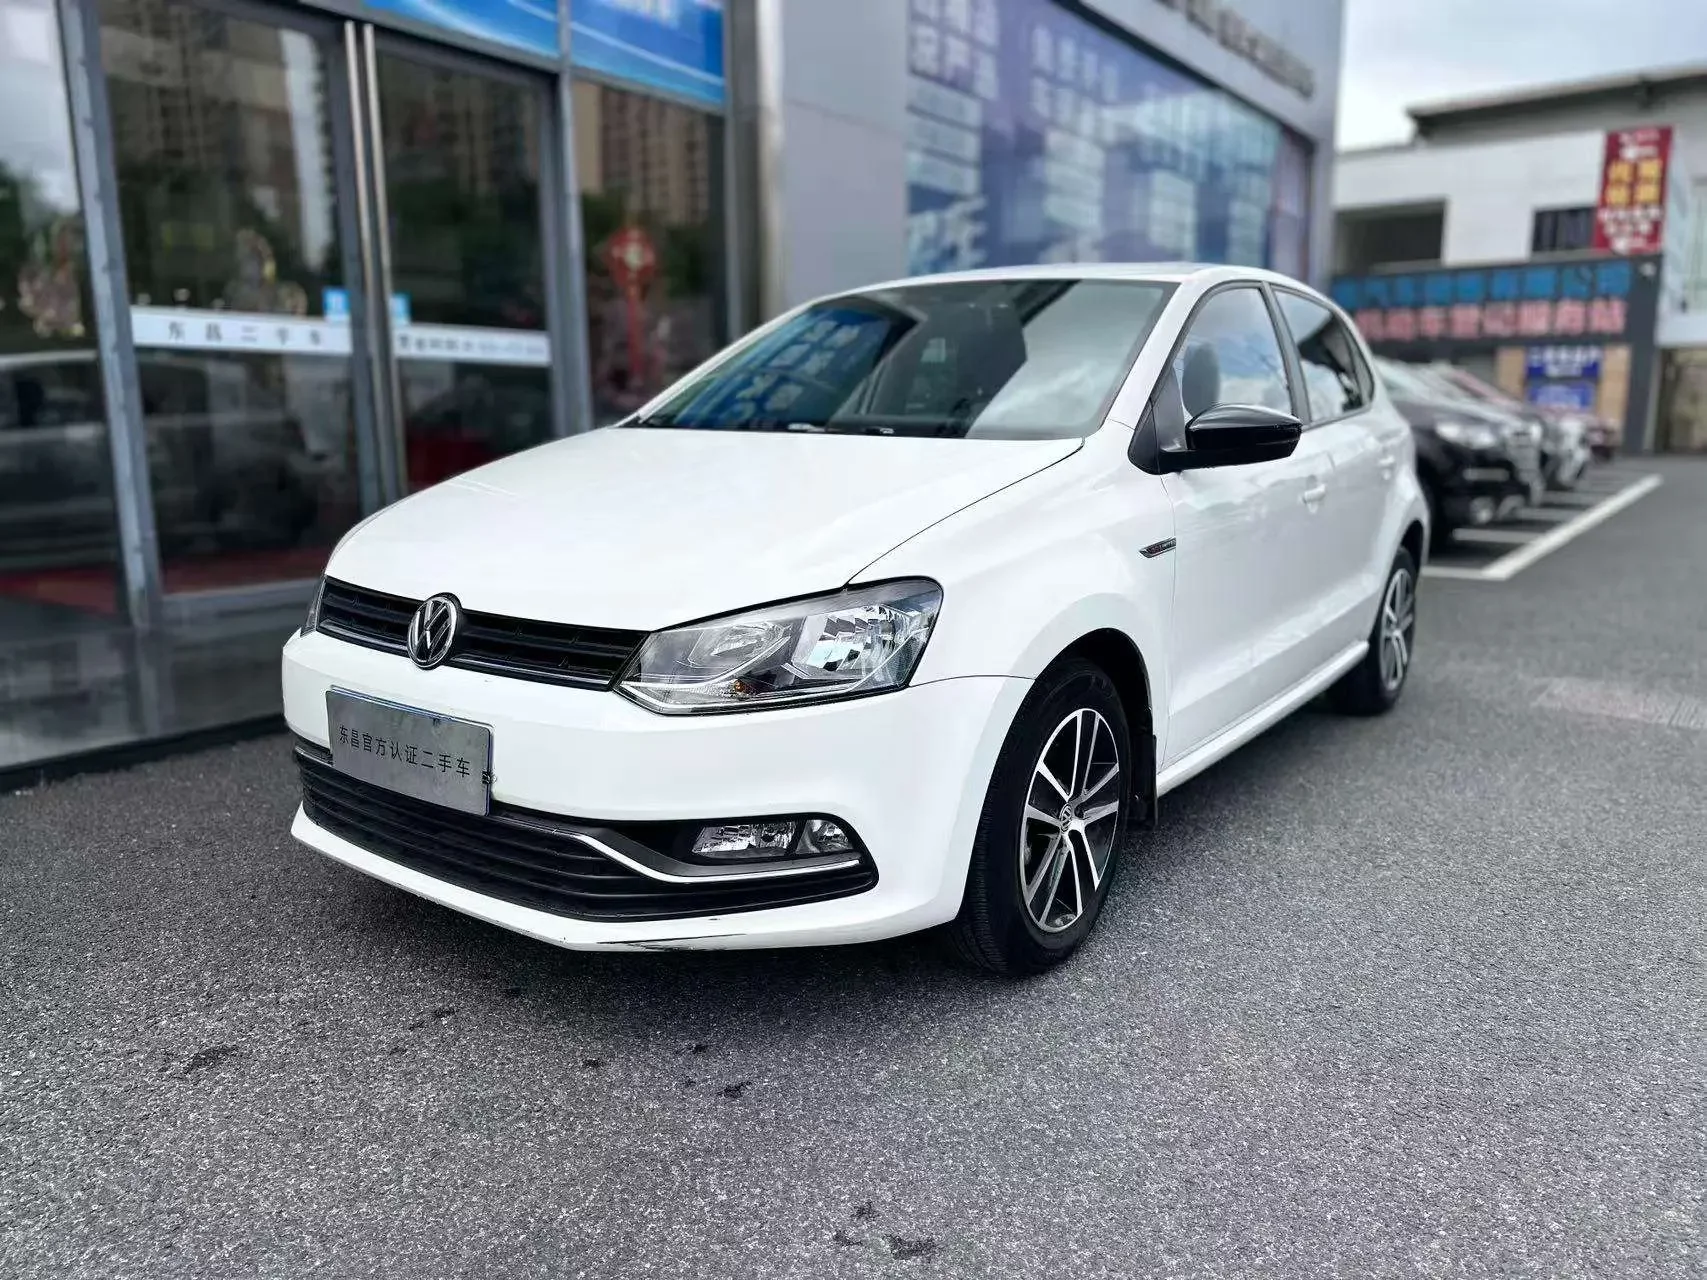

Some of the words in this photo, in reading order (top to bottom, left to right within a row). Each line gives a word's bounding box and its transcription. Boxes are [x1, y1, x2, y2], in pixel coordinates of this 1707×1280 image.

[168, 320, 321, 346] 东昌二手车
[338, 725, 470, 778] 东昌官方认证二手车
